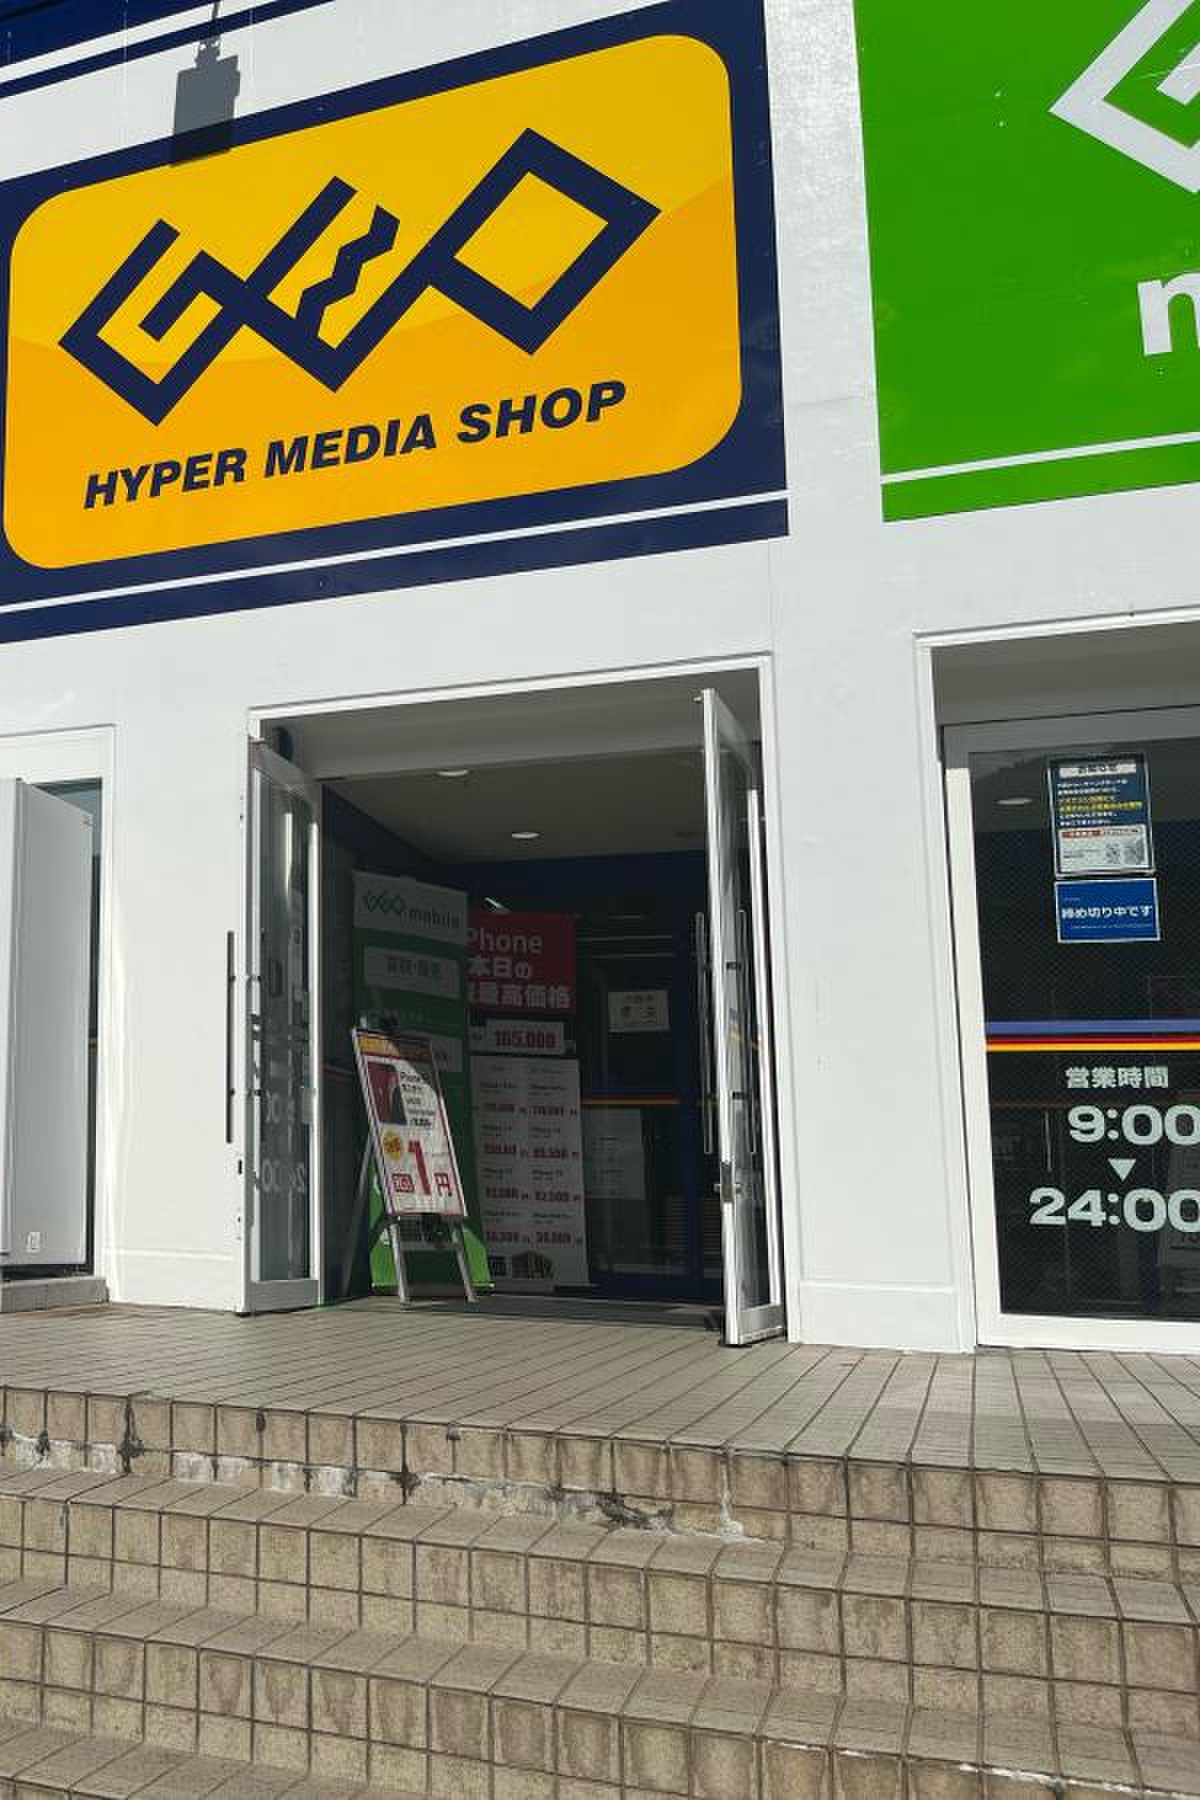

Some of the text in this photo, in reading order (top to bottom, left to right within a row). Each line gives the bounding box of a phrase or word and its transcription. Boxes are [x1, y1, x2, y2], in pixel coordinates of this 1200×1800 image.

[83, 379, 628, 511] HYPER MEDIA SHOP
[465, 927, 543, 954] Phone
[1065, 1066, 1169, 1089] 営業時間
[1067, 1104, 1200, 1146] 9:00
[1029, 1186, 1200, 1232] 24:00
